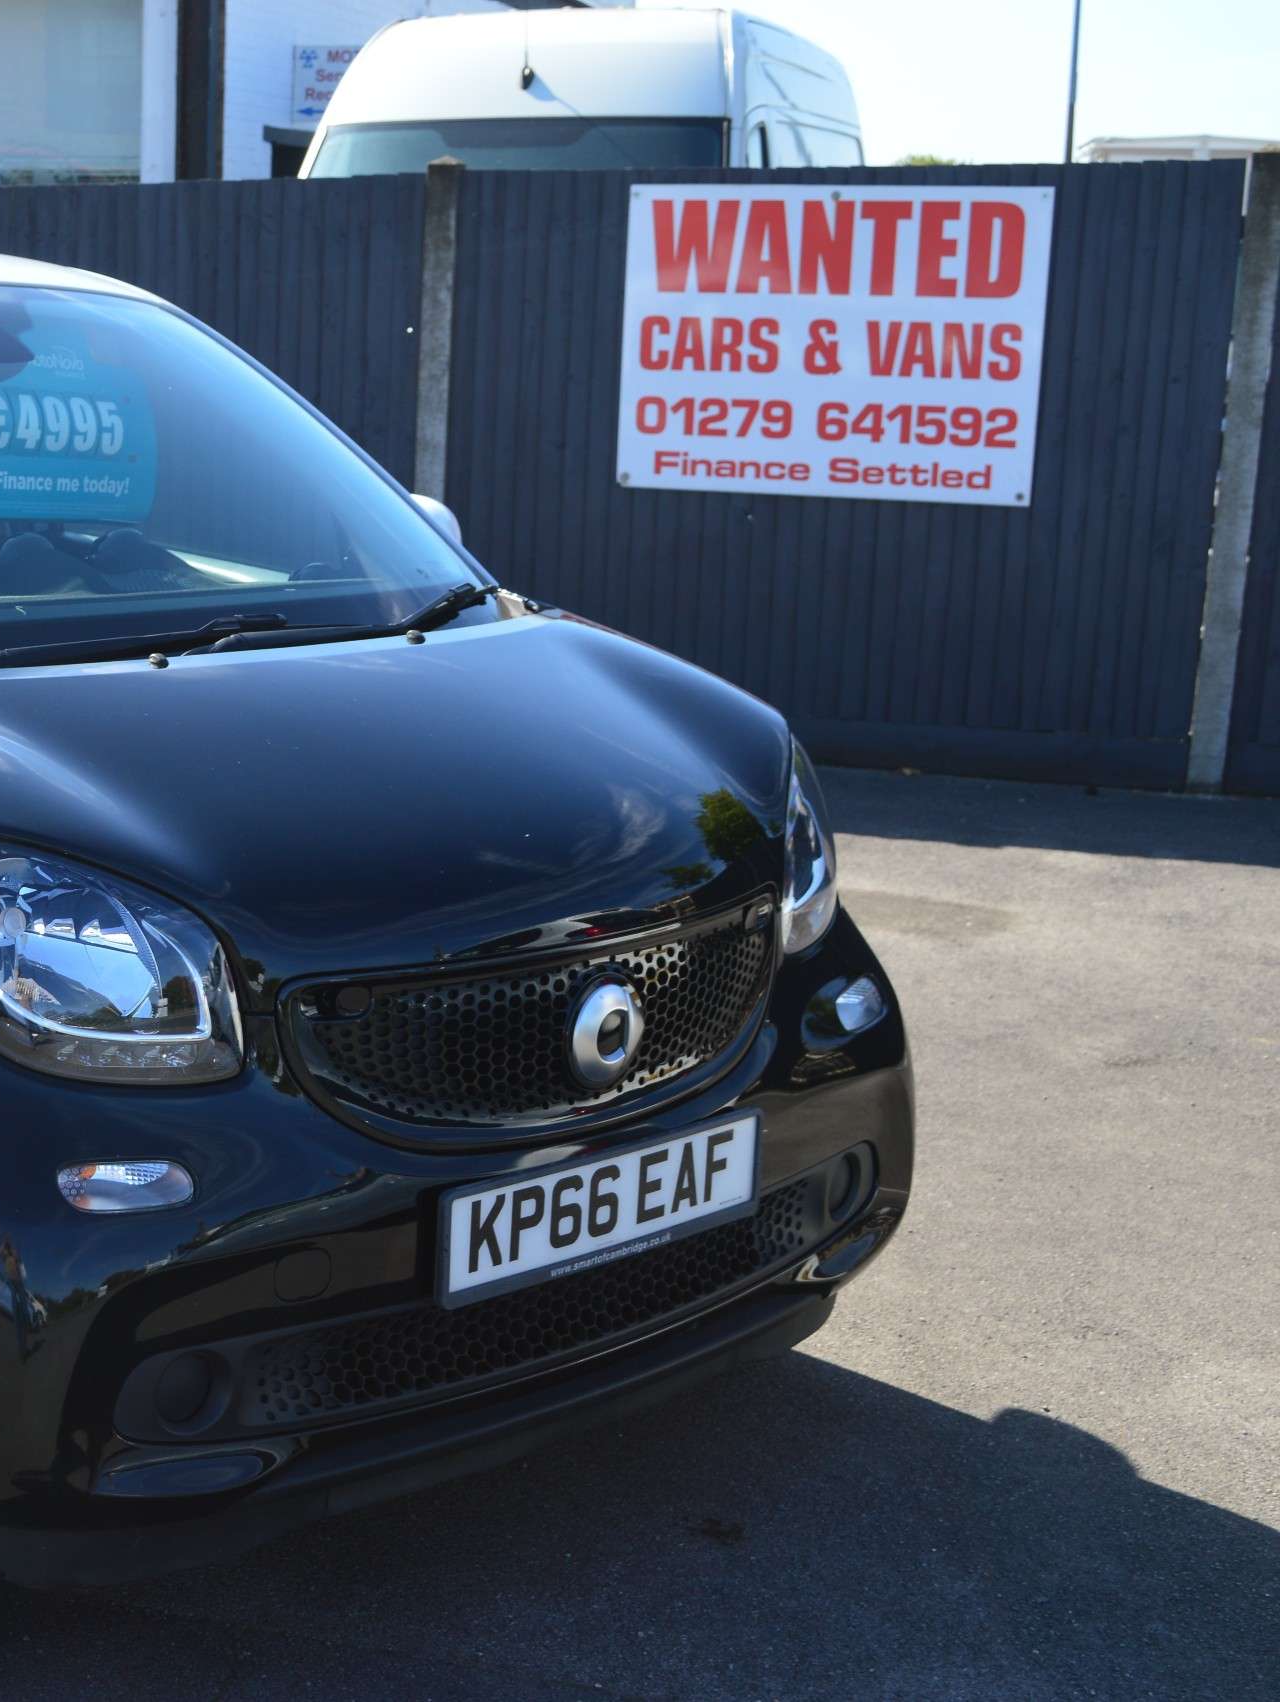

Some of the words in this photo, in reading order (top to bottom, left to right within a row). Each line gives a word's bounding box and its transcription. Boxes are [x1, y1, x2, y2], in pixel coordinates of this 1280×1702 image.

[652, 199, 1026, 298] WANTED
[639, 315, 780, 374] CARS
[802, 319, 842, 375] &
[866, 320, 1023, 381] VANS
[635, 395, 793, 439] 01279
[816, 401, 1018, 448] 641592
[56, 476, 80, 492] me
[83, 475, 131, 497] today!
[653, 450, 811, 481] Finance
[828, 457, 992, 490] Settled
[468, 1164, 621, 1273] KP66
[636, 1128, 734, 1224] EAF
